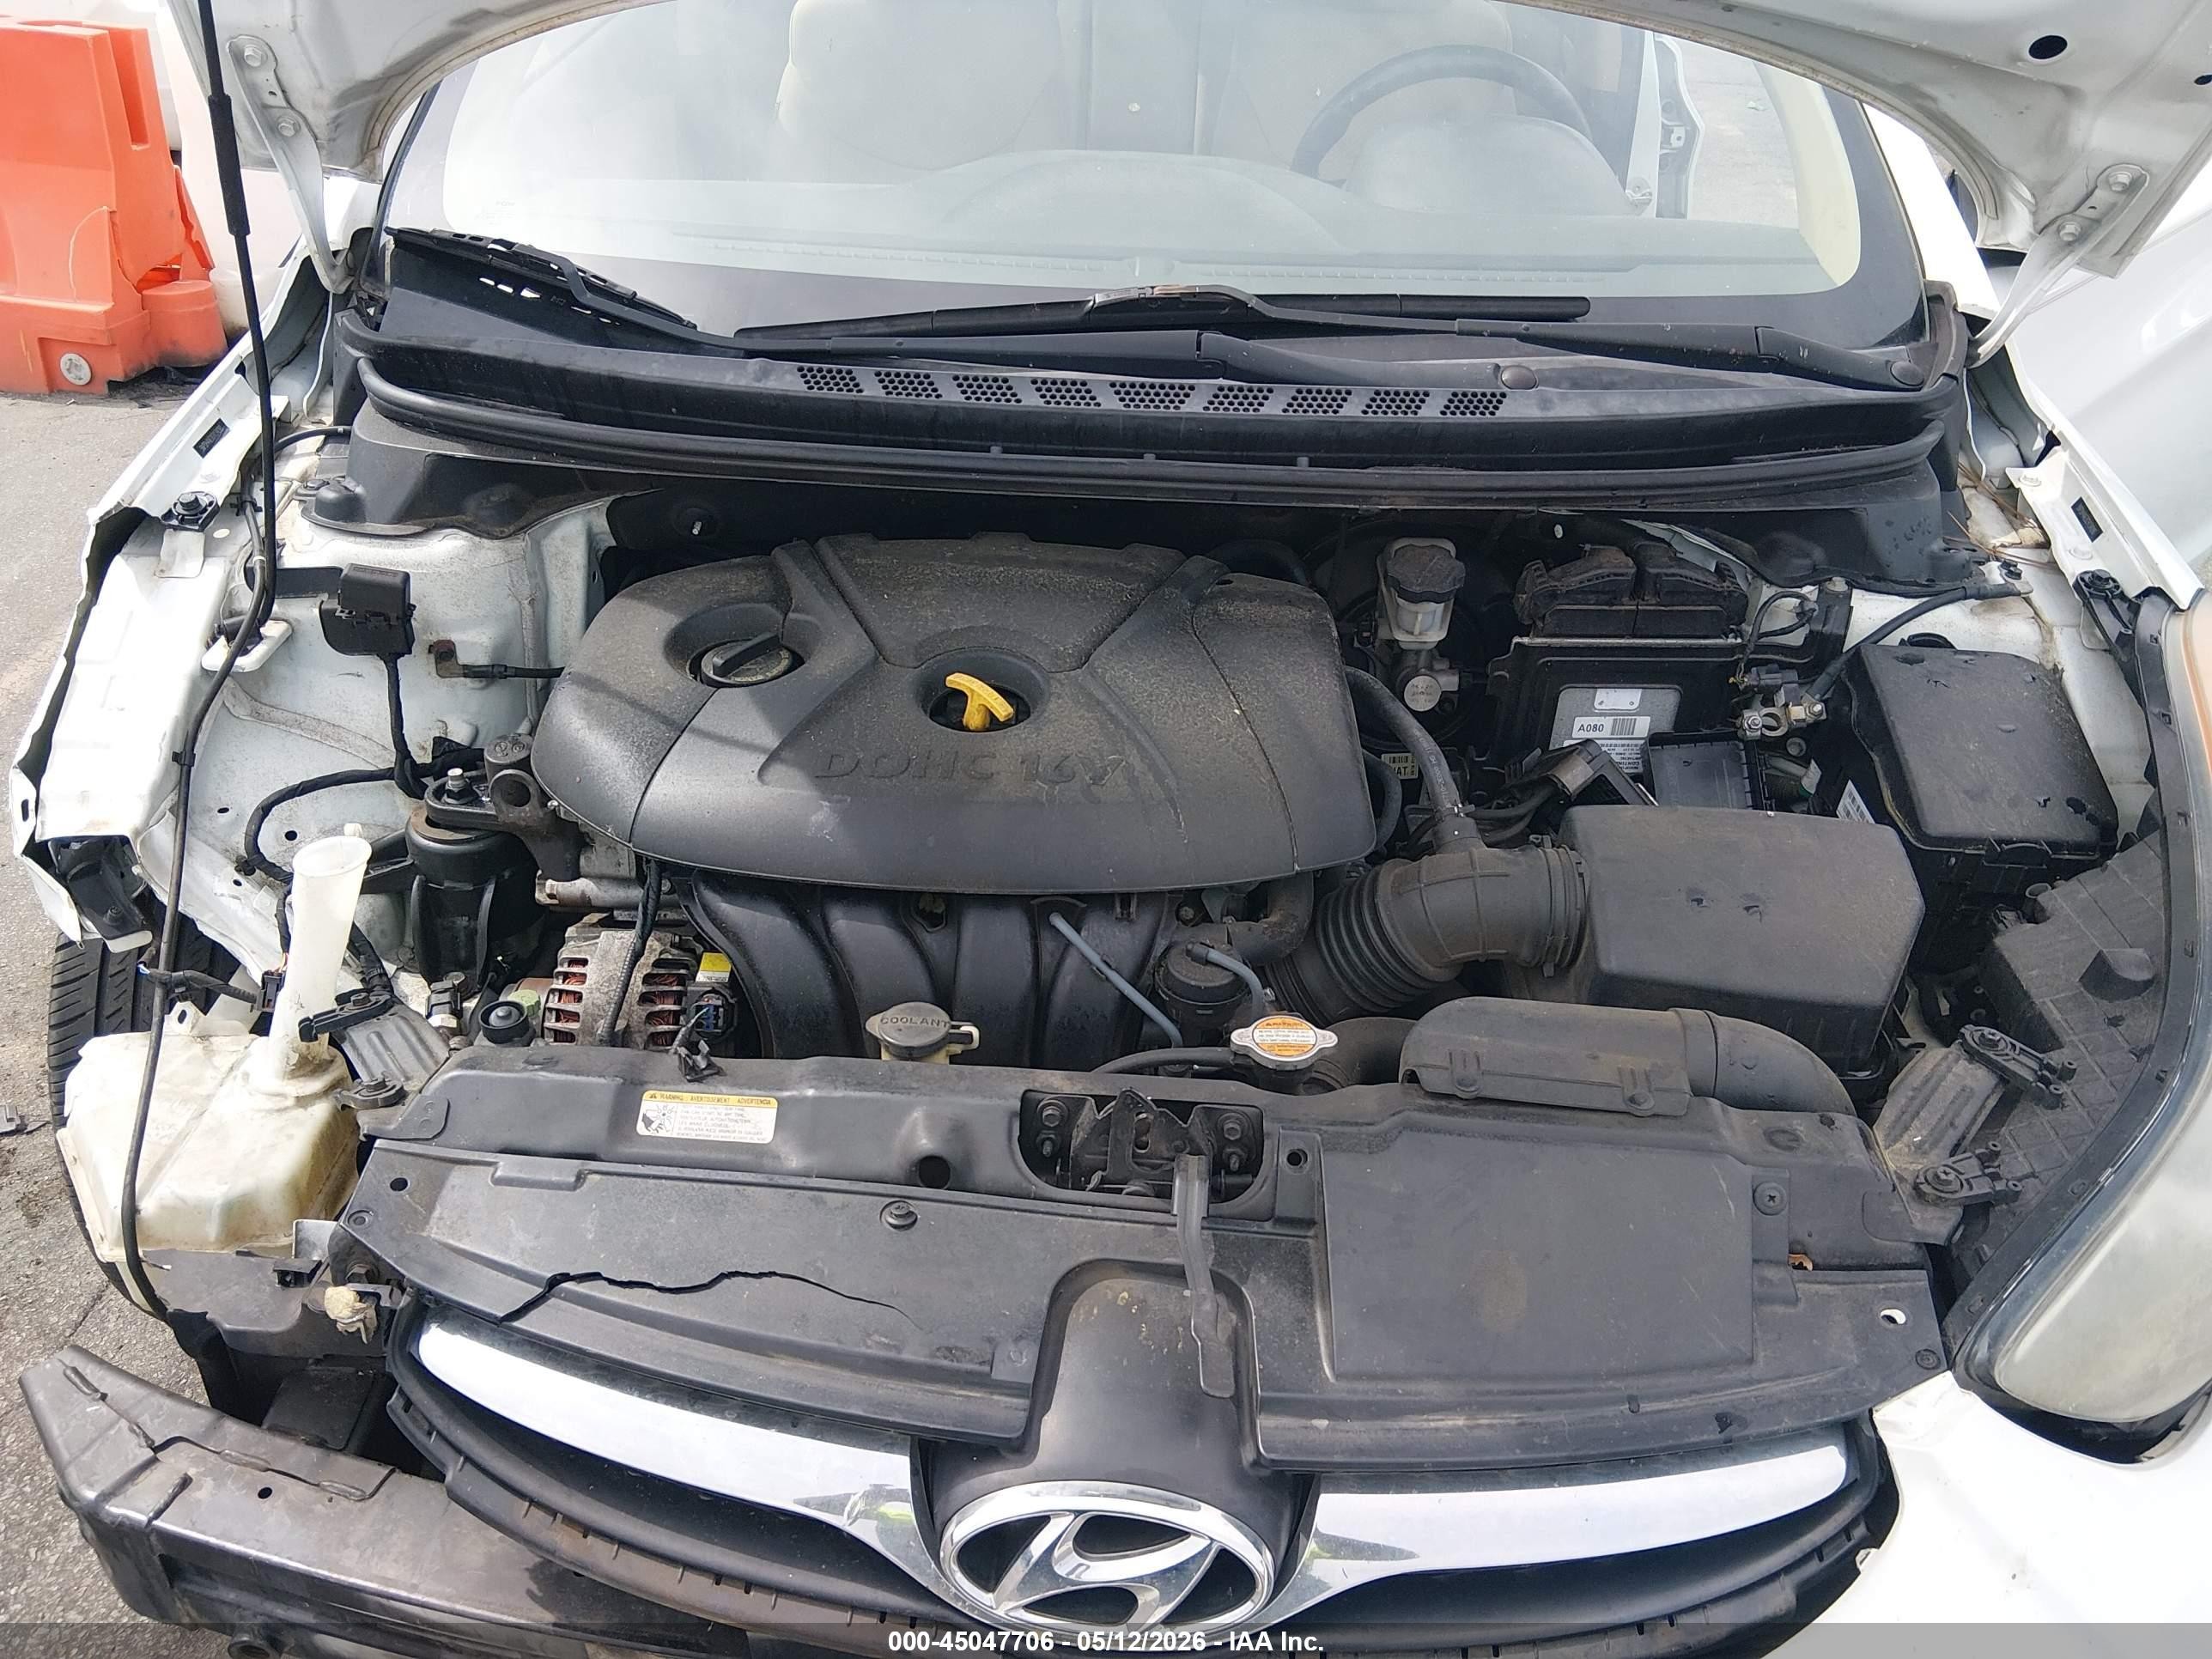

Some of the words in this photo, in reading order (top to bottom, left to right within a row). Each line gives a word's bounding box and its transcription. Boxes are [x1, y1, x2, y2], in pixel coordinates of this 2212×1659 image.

[1577, 723, 1604, 732] A080
[811, 751, 997, 779] DOHC
[1020, 754, 1127, 786] 16V
[880, 1016, 951, 1028] COOLANT
